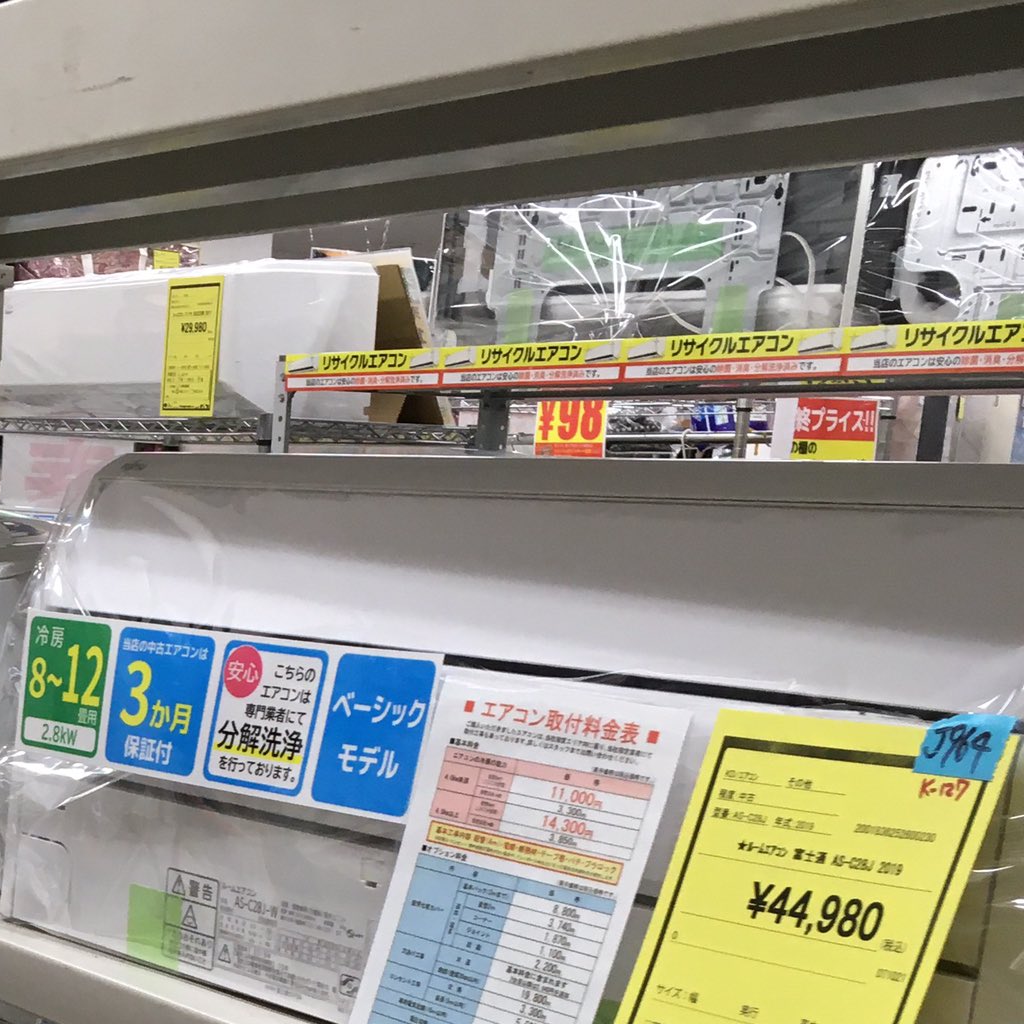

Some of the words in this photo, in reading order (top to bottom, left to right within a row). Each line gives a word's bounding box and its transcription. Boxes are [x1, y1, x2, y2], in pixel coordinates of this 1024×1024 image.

[671, 335, 794, 357] リサイクルエアコン
[905, 323, 1024, 347] リサイクルエア
[322, 352, 407, 370] リサイクルエアコン
[480, 345, 583, 364] リサイクルエアコン
[36, 624, 64, 649] 冷房
[122, 637, 209, 660] 当店の中古エアコンは
[28, 643, 103, 707] 8~12
[228, 661, 259, 684] 安心
[274, 663, 316, 683] こちらの
[120, 660, 192, 735] 3か月
[260, 685, 312, 705] エアコンは
[244, 703, 306, 726] 専門業者にて
[332, 692, 427, 729] ベーシック
[42, 723, 78, 747] 2.8kW
[480, 702, 641, 745] エアコン取付料金表
[123, 737, 173, 765] 保証付
[217, 720, 303, 761] 分解洗浄
[219, 757, 296, 783] を行っております。
[338, 747, 399, 780] モデル
[877, 862, 904, 876] 2019
[746, 881, 884, 942] ¥44,980
